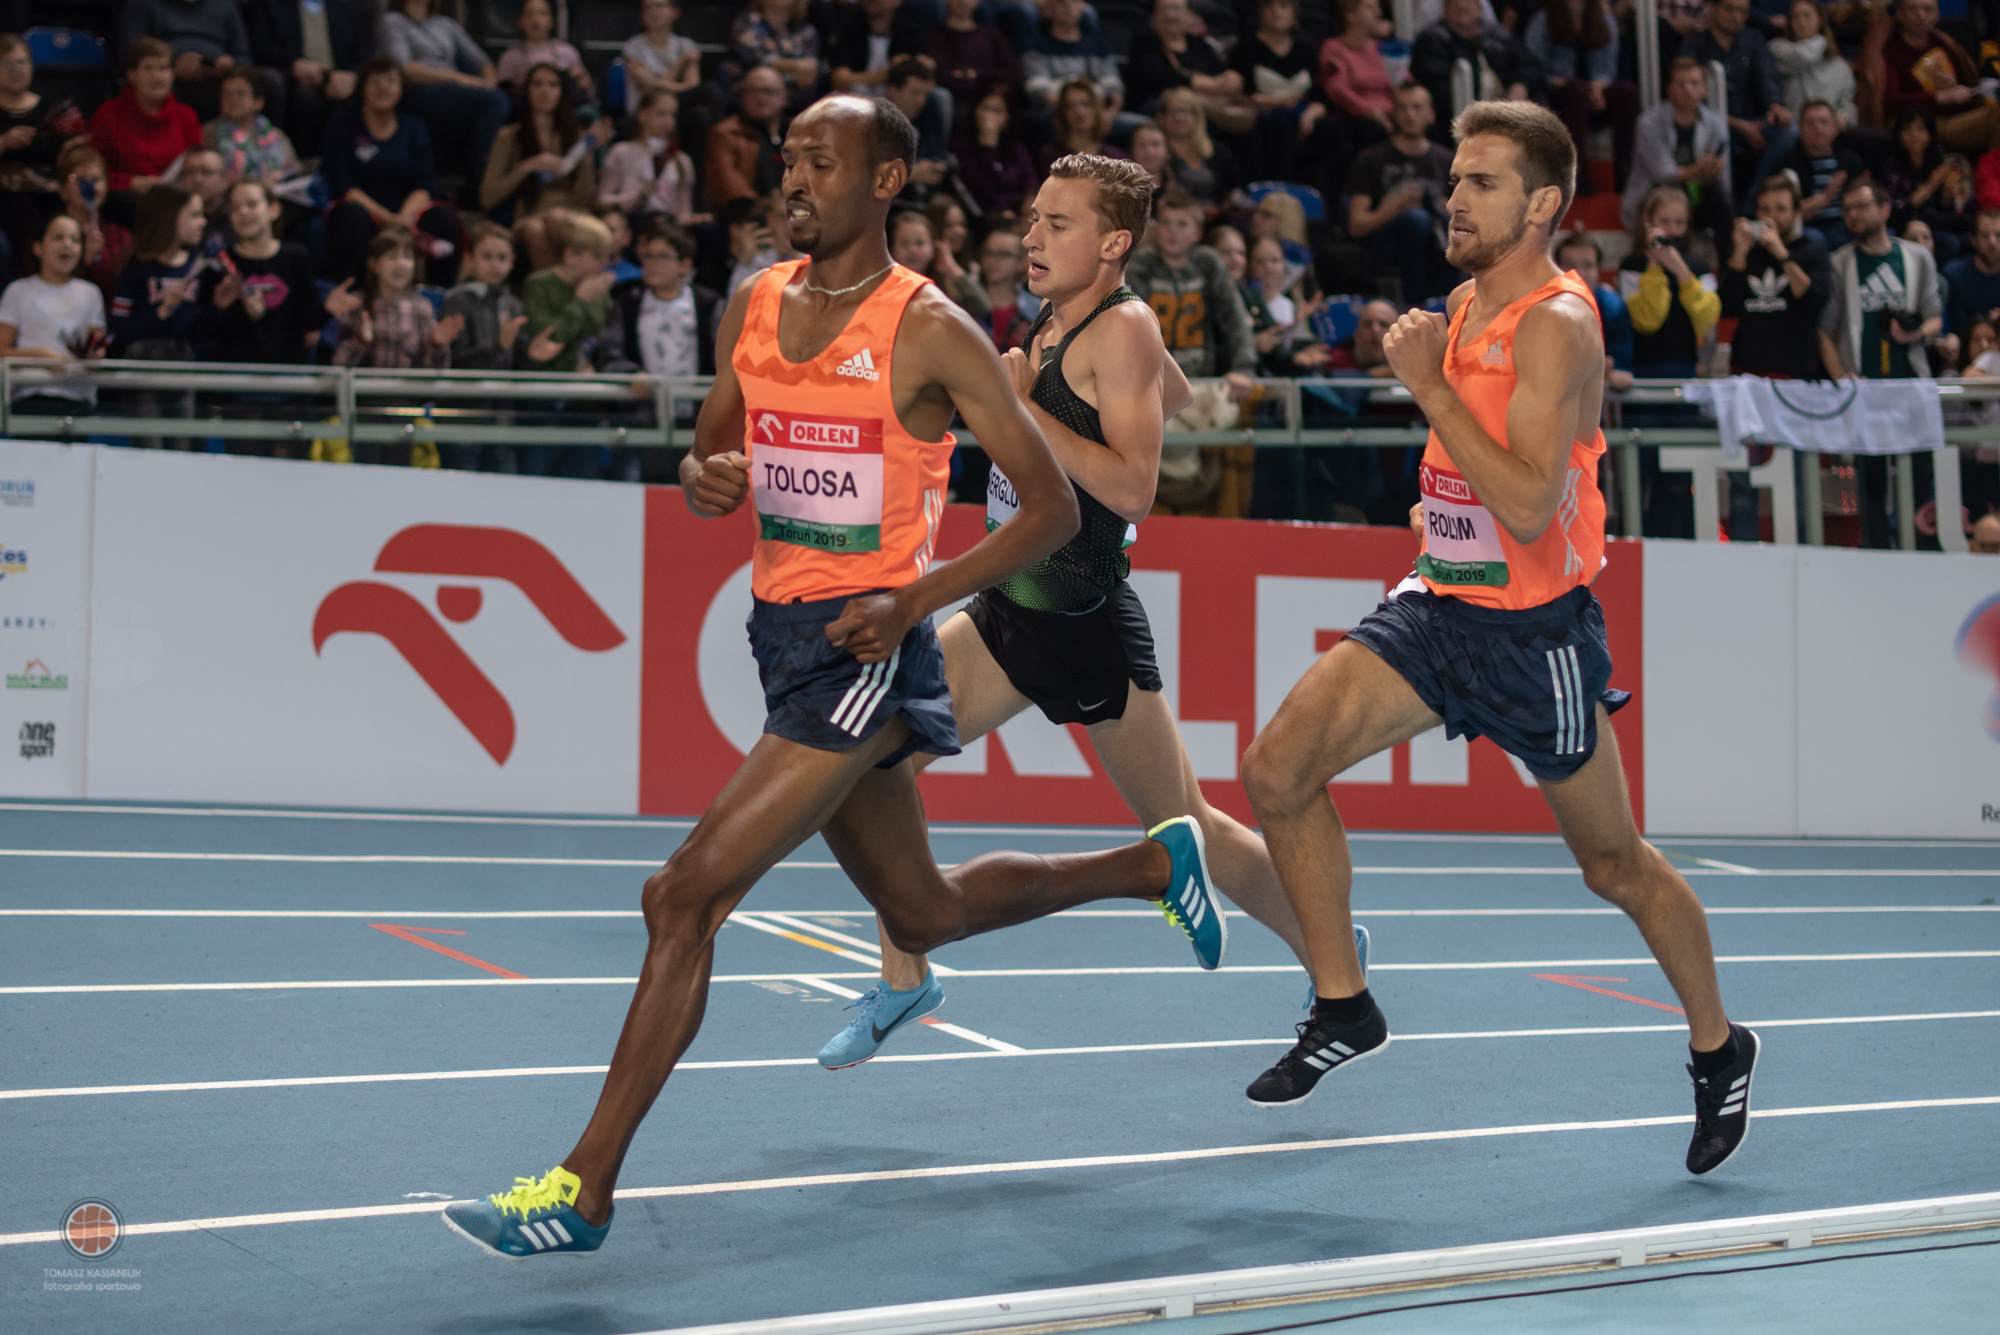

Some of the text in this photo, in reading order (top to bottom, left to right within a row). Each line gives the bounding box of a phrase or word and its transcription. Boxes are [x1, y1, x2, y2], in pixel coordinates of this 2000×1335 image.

[836, 364, 880, 381] adidas
[793, 424, 855, 444] ORLEN
[764, 463, 859, 499] TOLOSA
[1438, 476, 1469, 497] ORLEN
[778, 524, 847, 547] Toruń 2019
[830, 525, 849, 533] Tour
[1455, 569, 1486, 582] 2019
[19, 721, 56, 741] one
